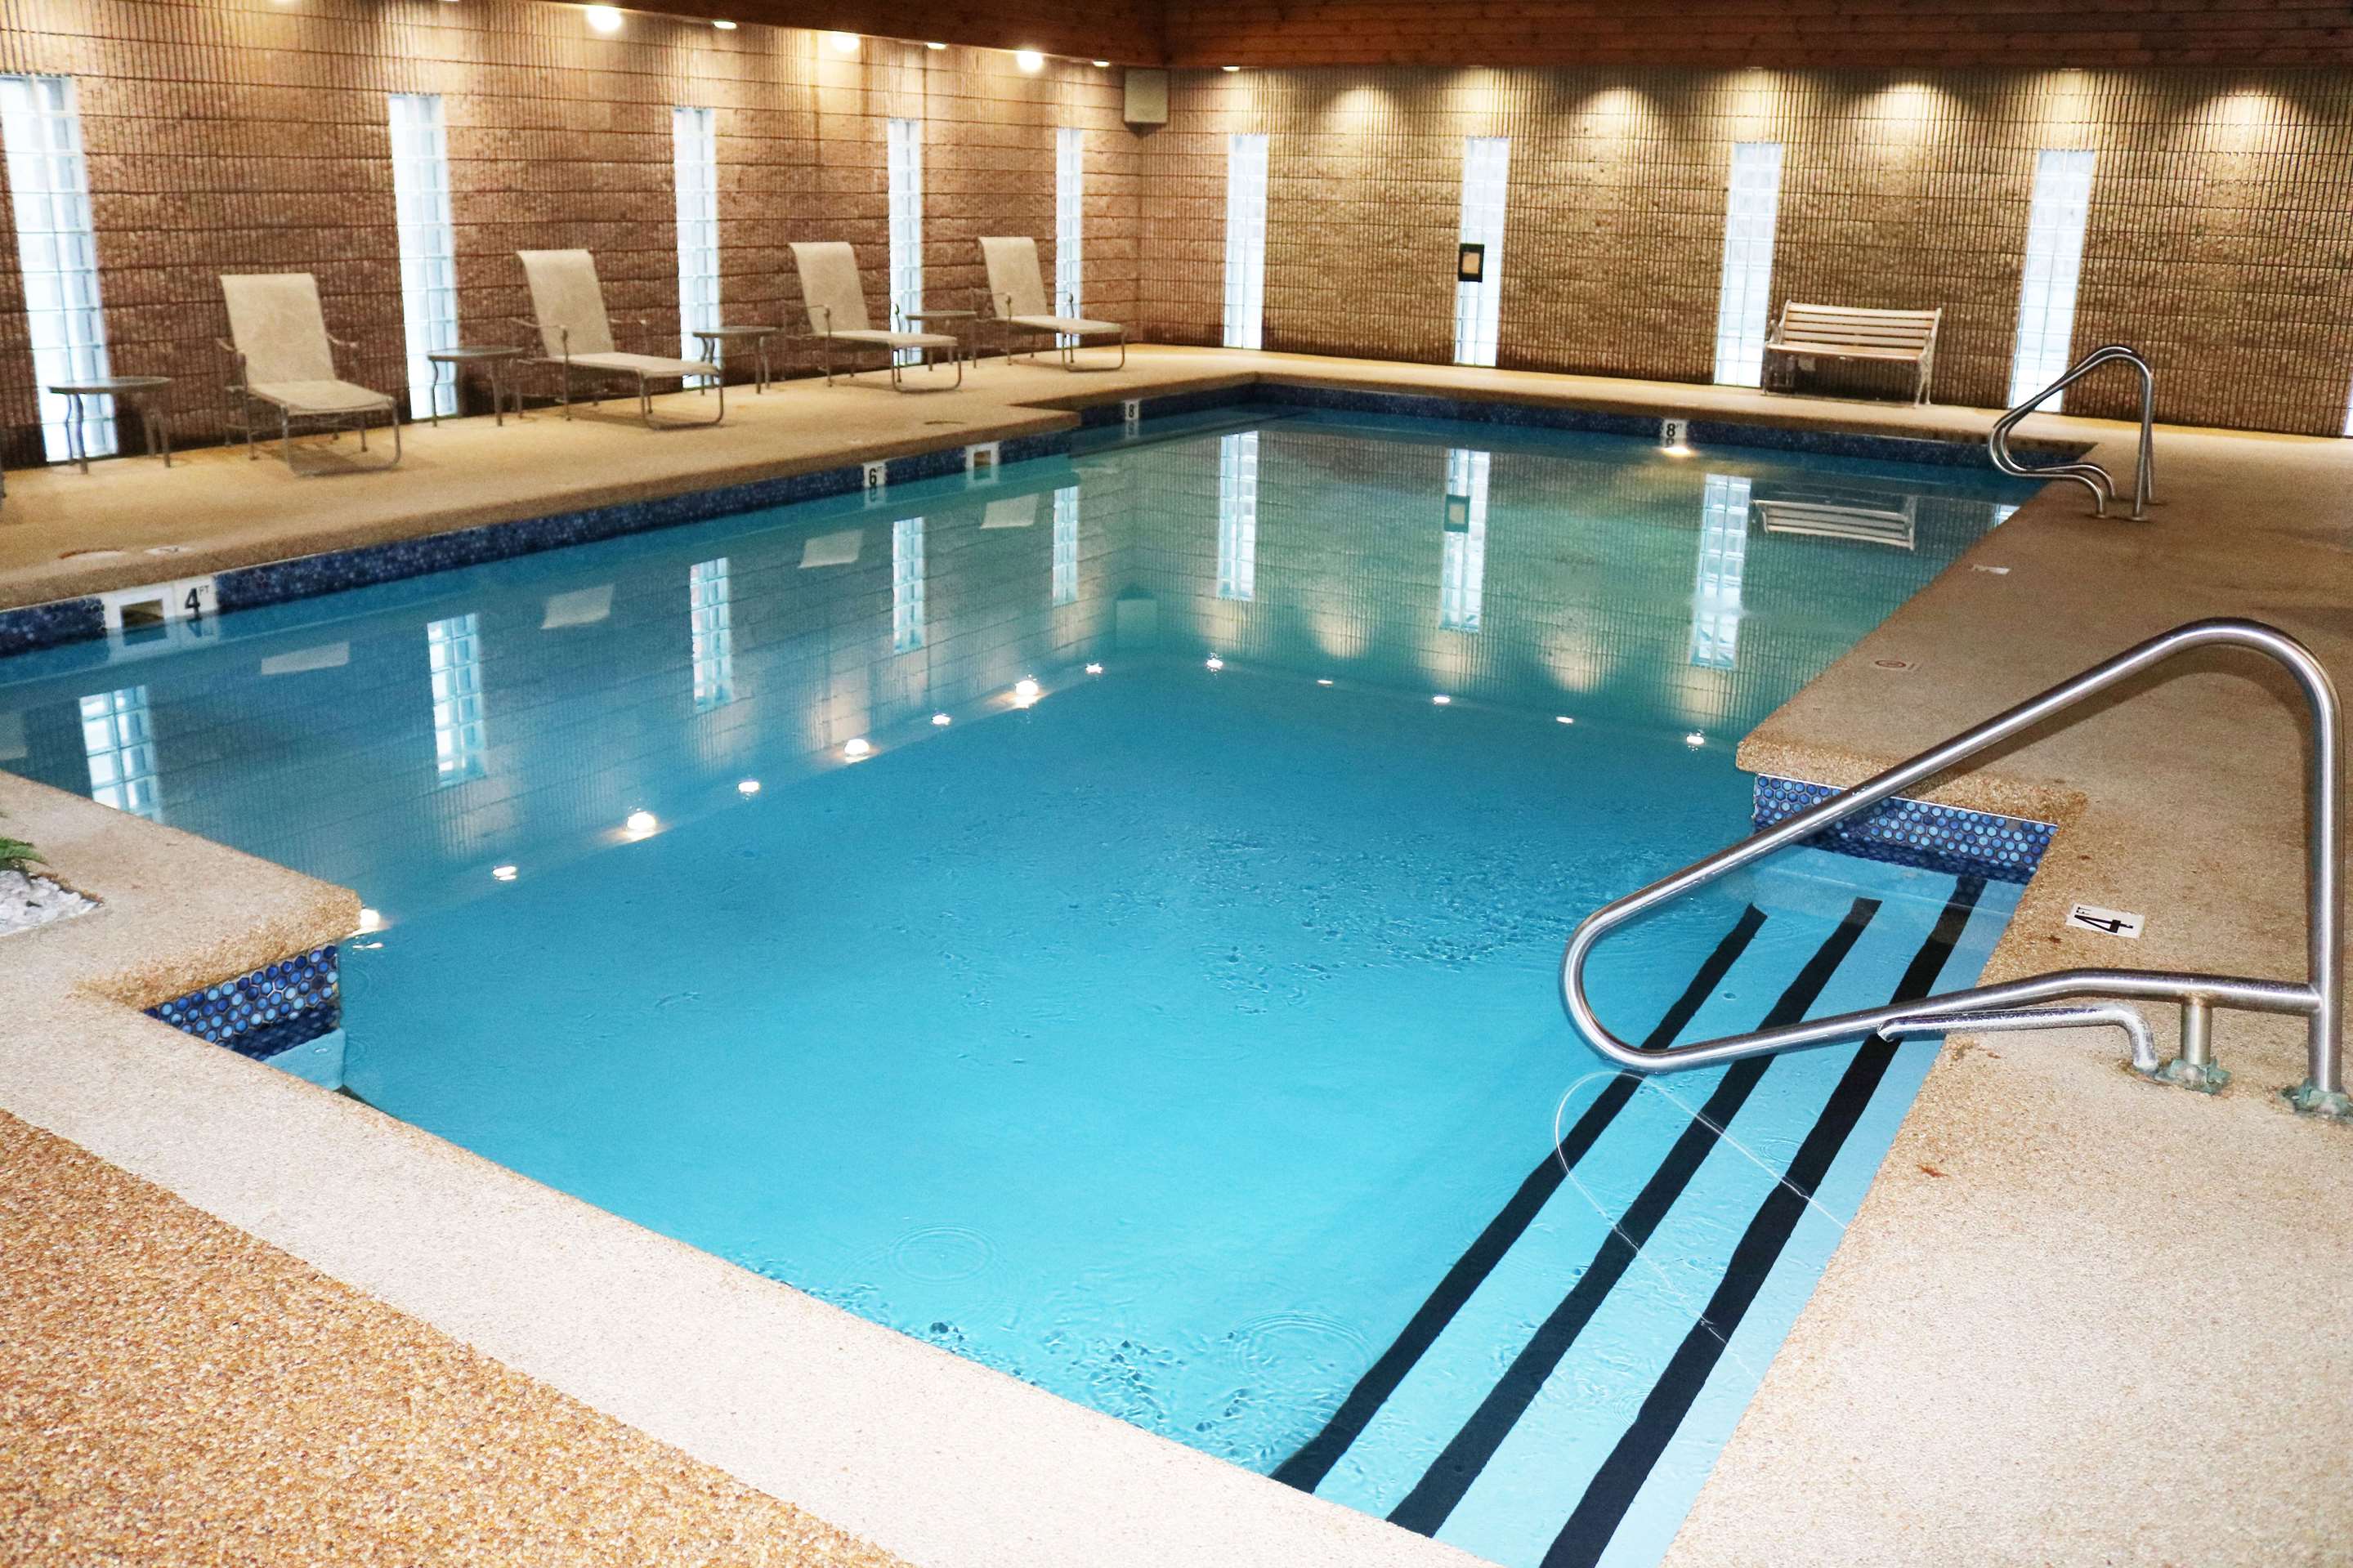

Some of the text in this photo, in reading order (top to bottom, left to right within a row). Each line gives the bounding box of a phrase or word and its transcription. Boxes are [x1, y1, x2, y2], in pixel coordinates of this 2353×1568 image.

[1129, 404, 1134, 418] 8
[1666, 423, 1675, 436] 8
[869, 467, 877, 485] 6
[185, 587, 200, 614] 4
[2074, 914, 2133, 933] 4
